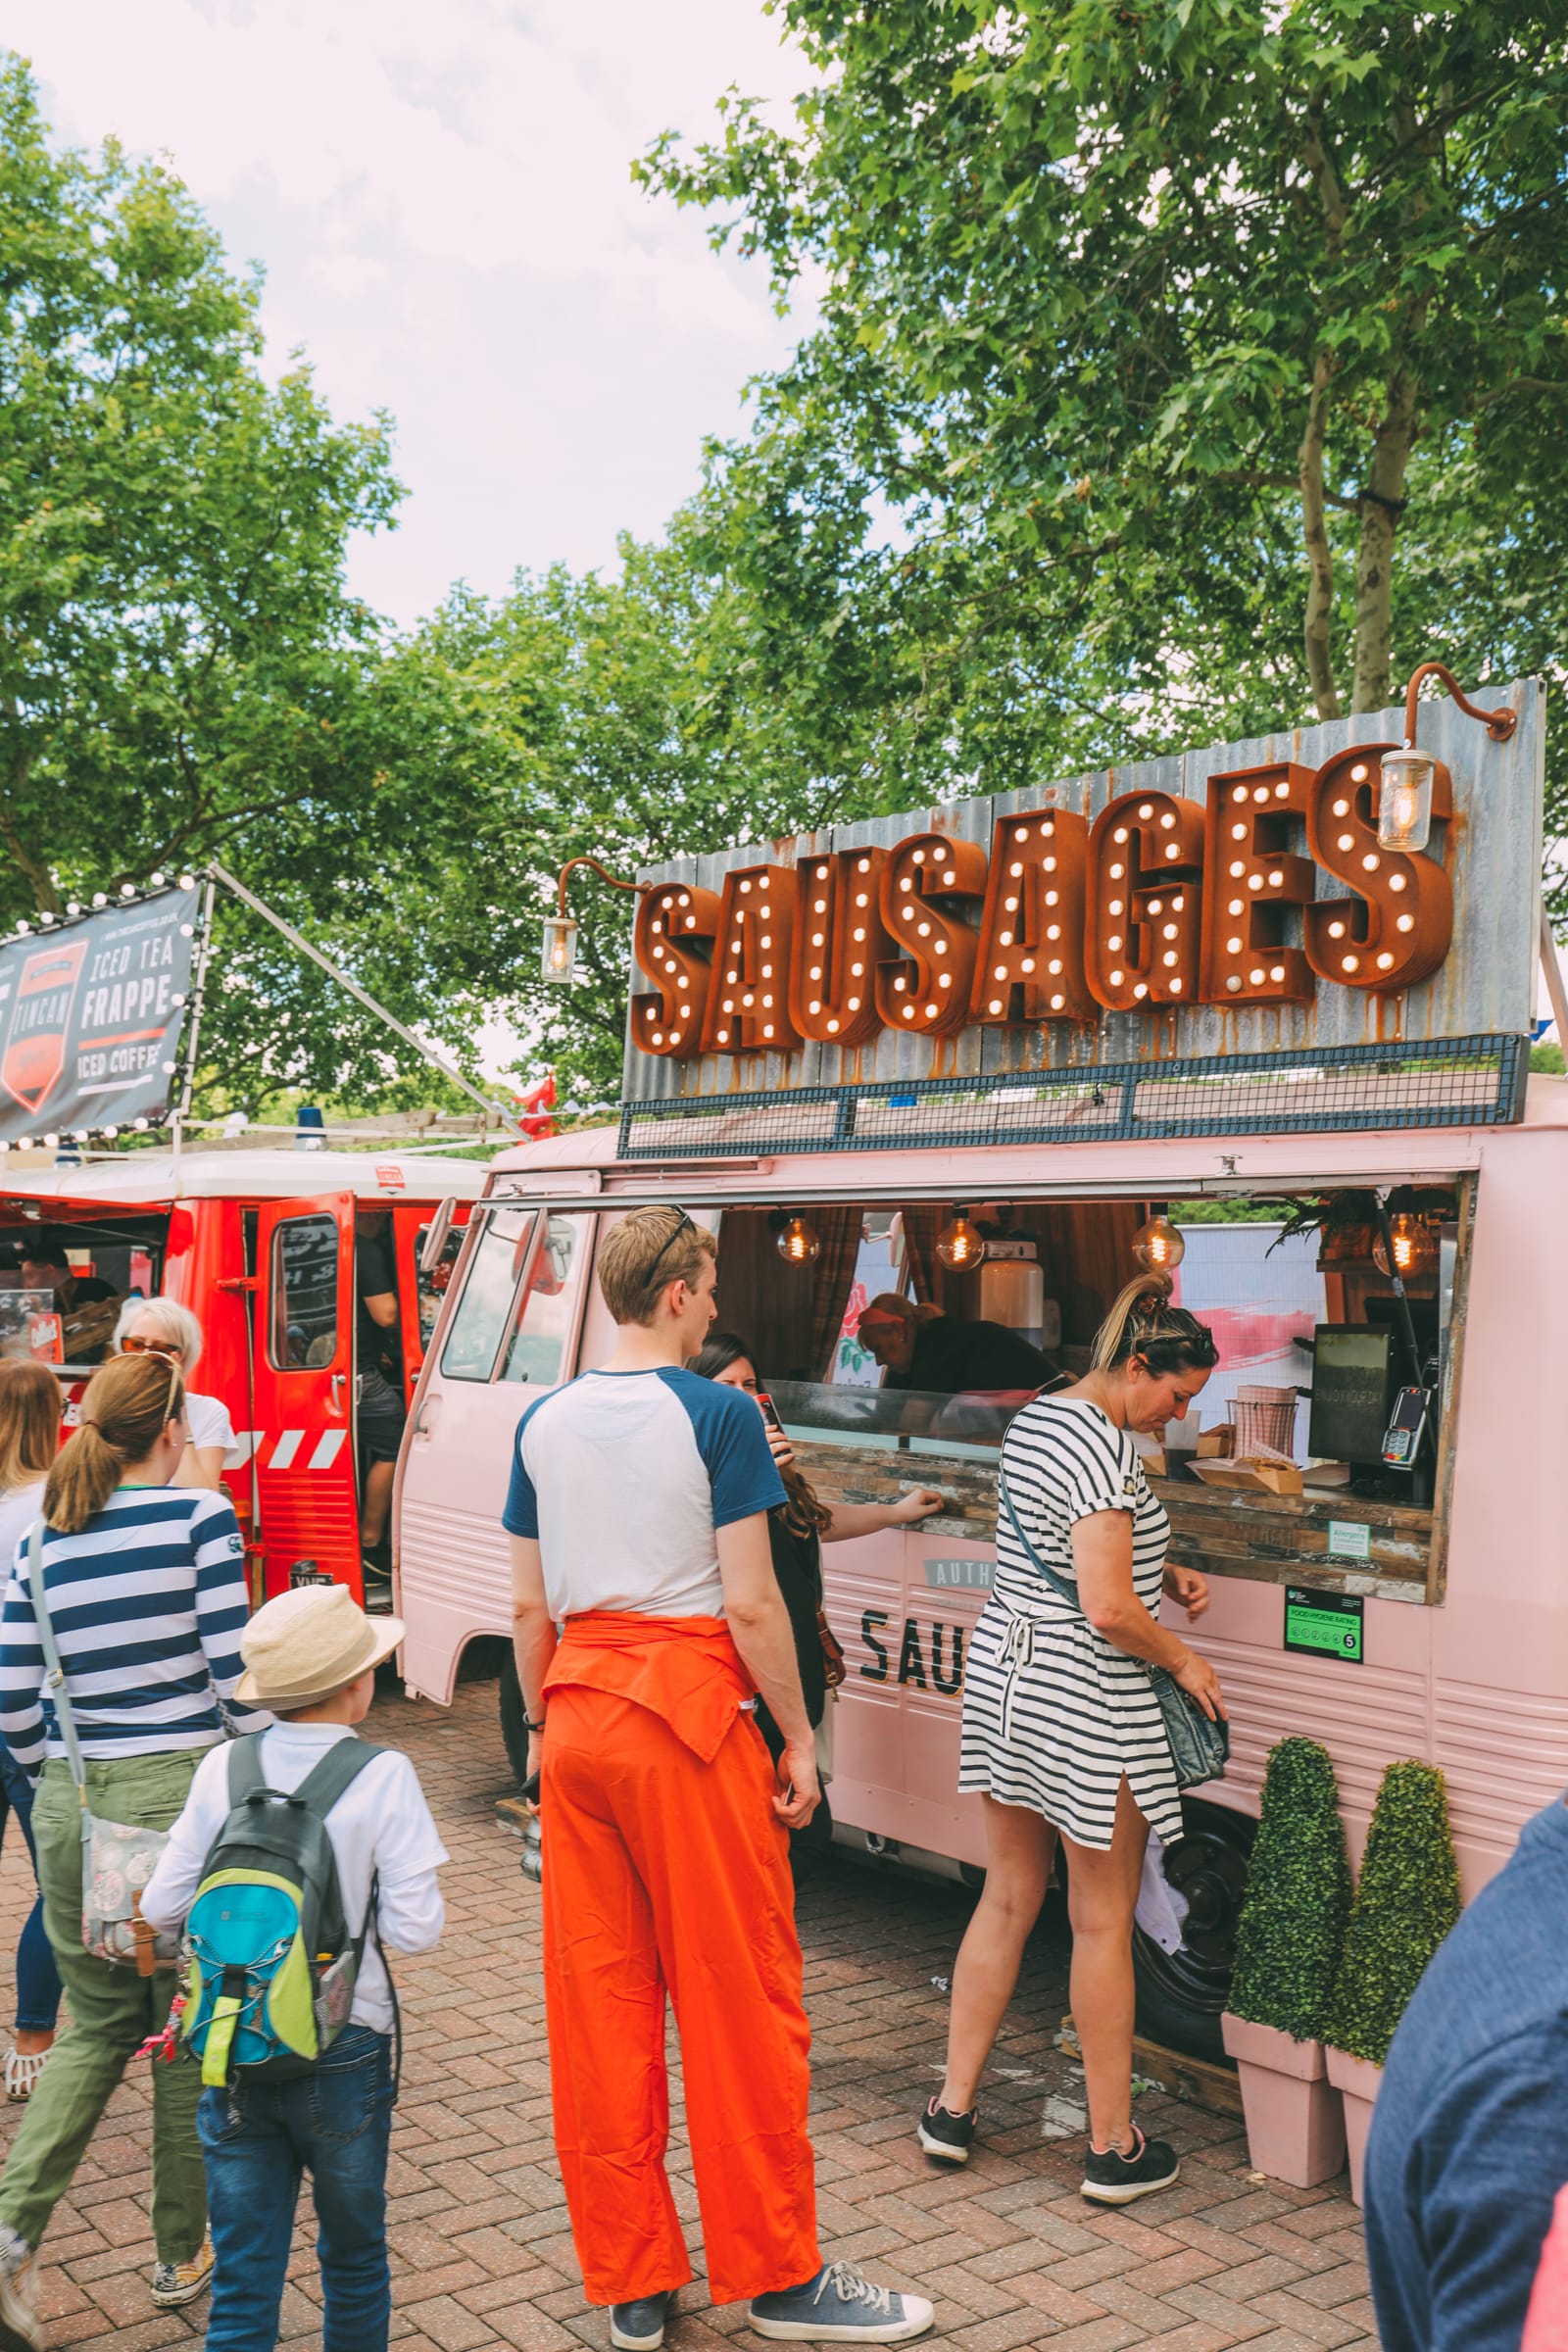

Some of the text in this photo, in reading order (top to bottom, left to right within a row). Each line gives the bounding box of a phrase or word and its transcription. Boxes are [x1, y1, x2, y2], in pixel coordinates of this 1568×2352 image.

[631, 743, 1454, 1059] SAUSAGES
[89, 945, 131, 983] ICED
[140, 934, 173, 970] TEA
[13, 990, 70, 1036] TINCAN
[81, 974, 172, 1029] FRAPPE
[77, 1051, 105, 1079] ICED
[936, 1562, 990, 1585] AUTH
[860, 1609, 964, 1697] SAU
[1345, 1635, 1354, 1647] 5
